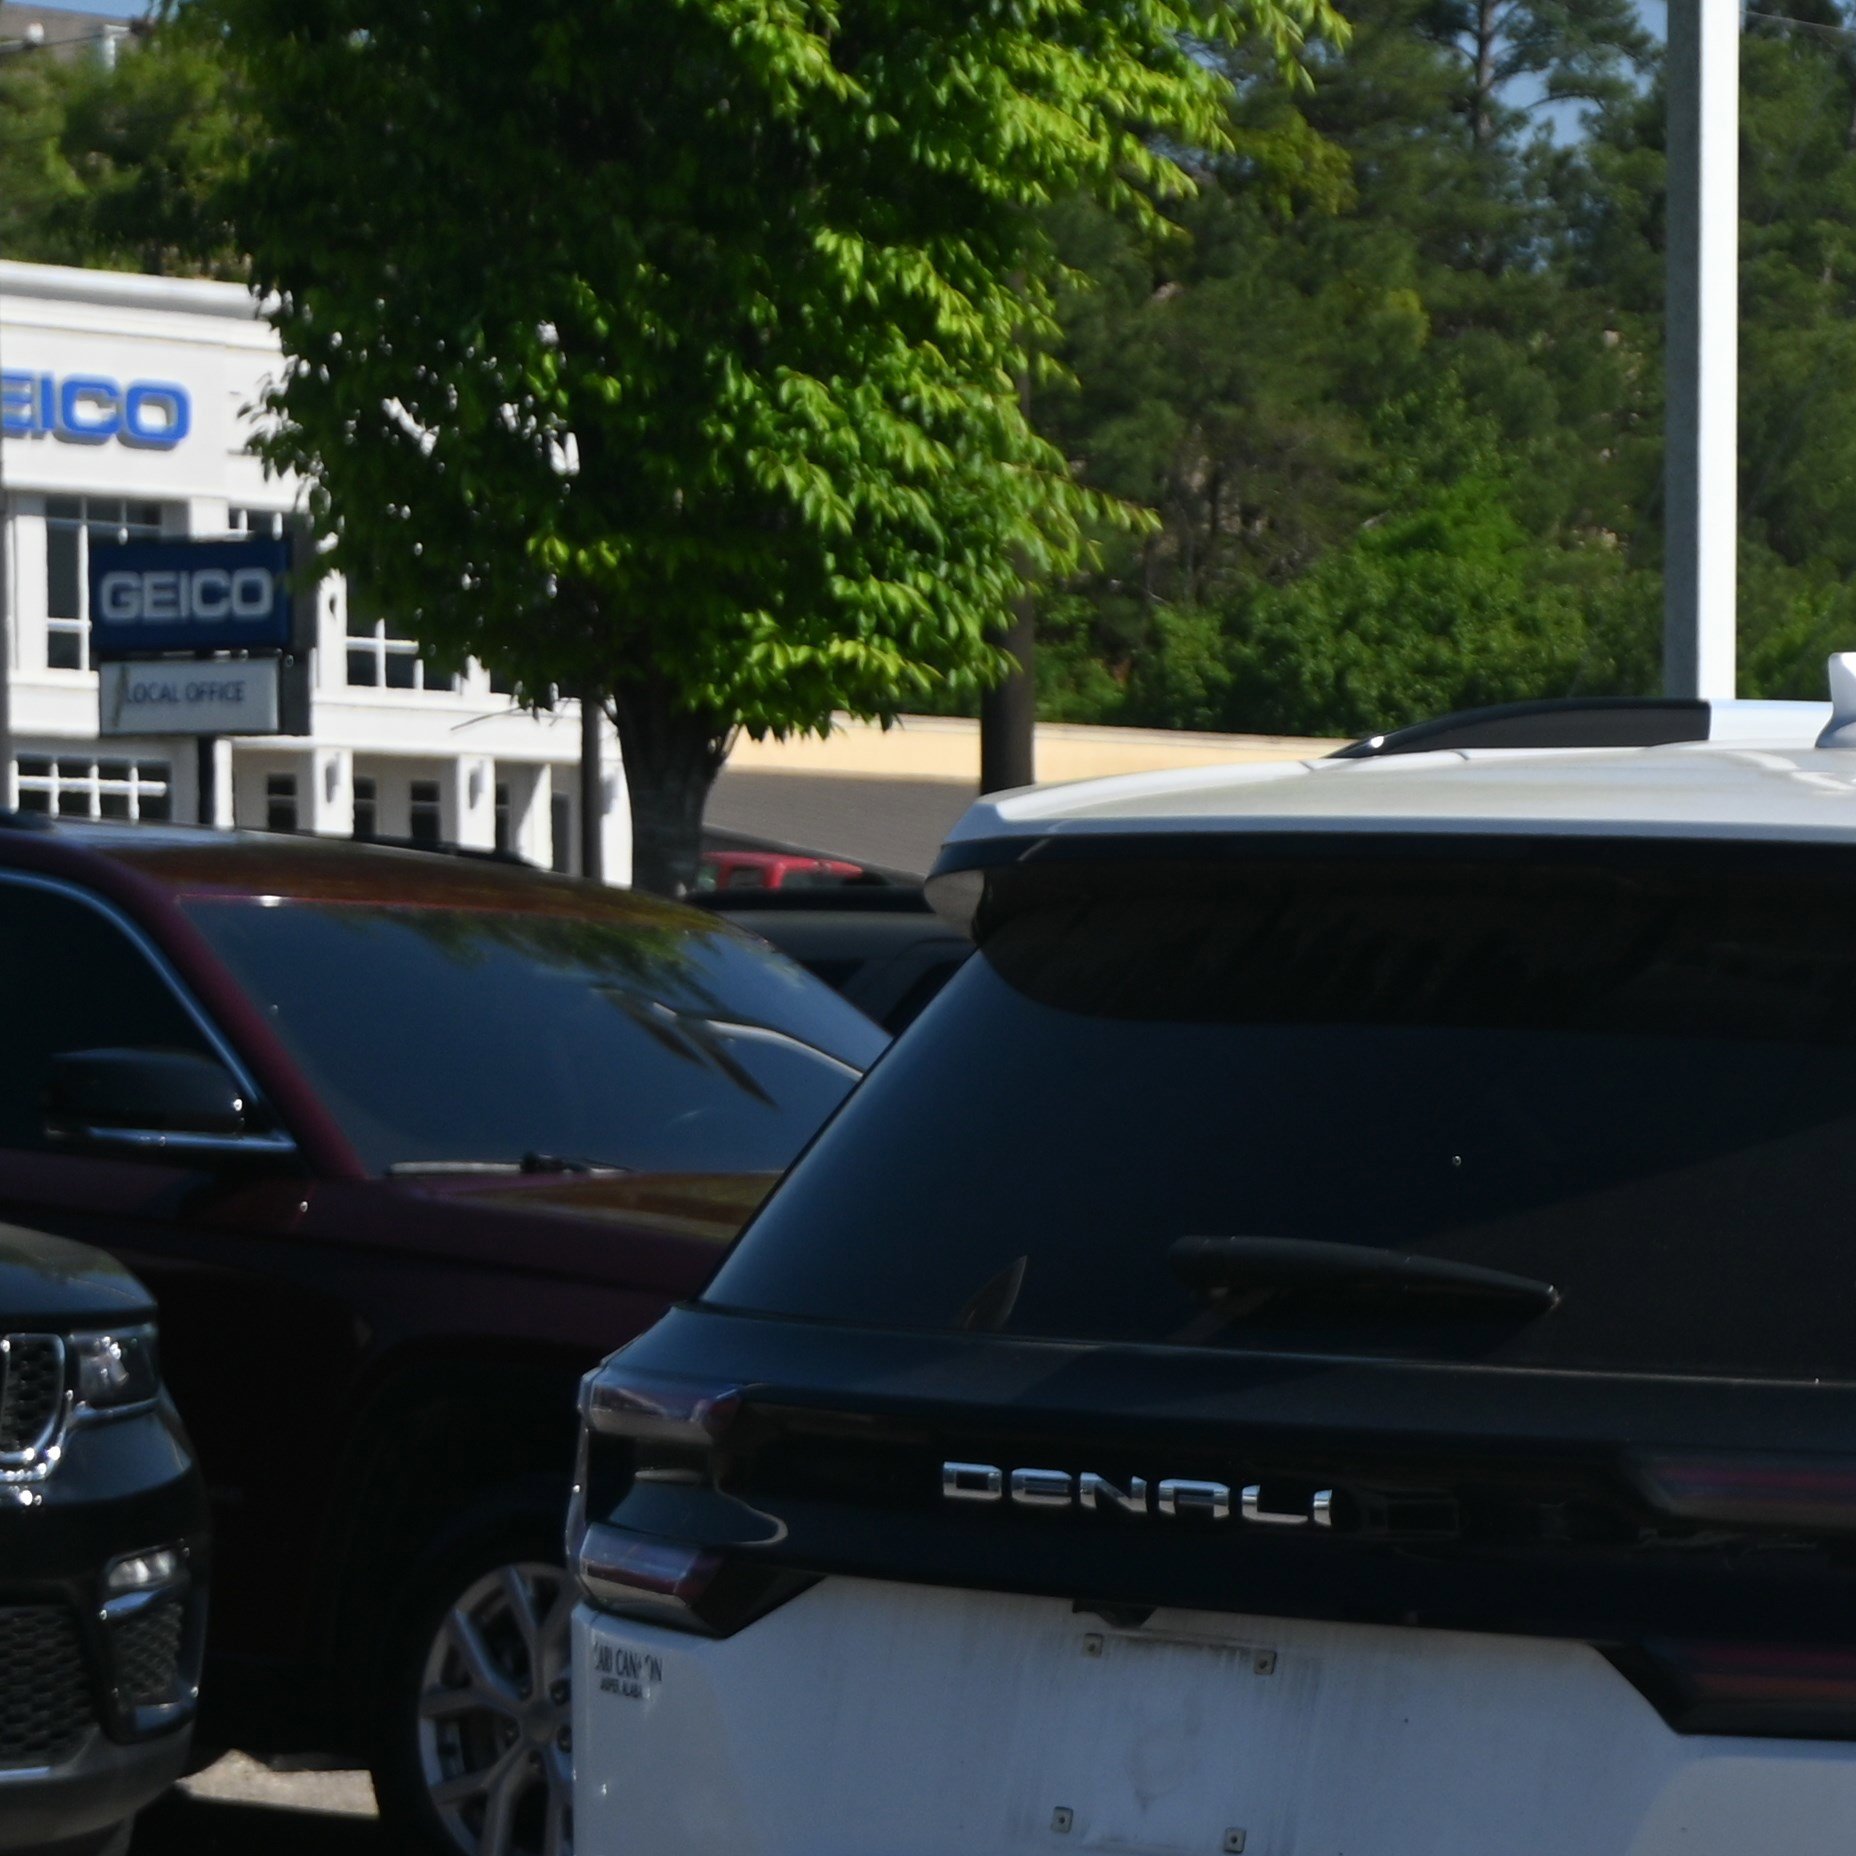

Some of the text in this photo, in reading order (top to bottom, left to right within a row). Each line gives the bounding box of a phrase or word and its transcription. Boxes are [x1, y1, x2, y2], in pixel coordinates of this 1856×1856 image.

[0, 368, 191, 443] EICO
[101, 567, 274, 621] GEICO
[185, 680, 246, 701] OFFICE
[943, 1461, 1332, 1526] DENALI
